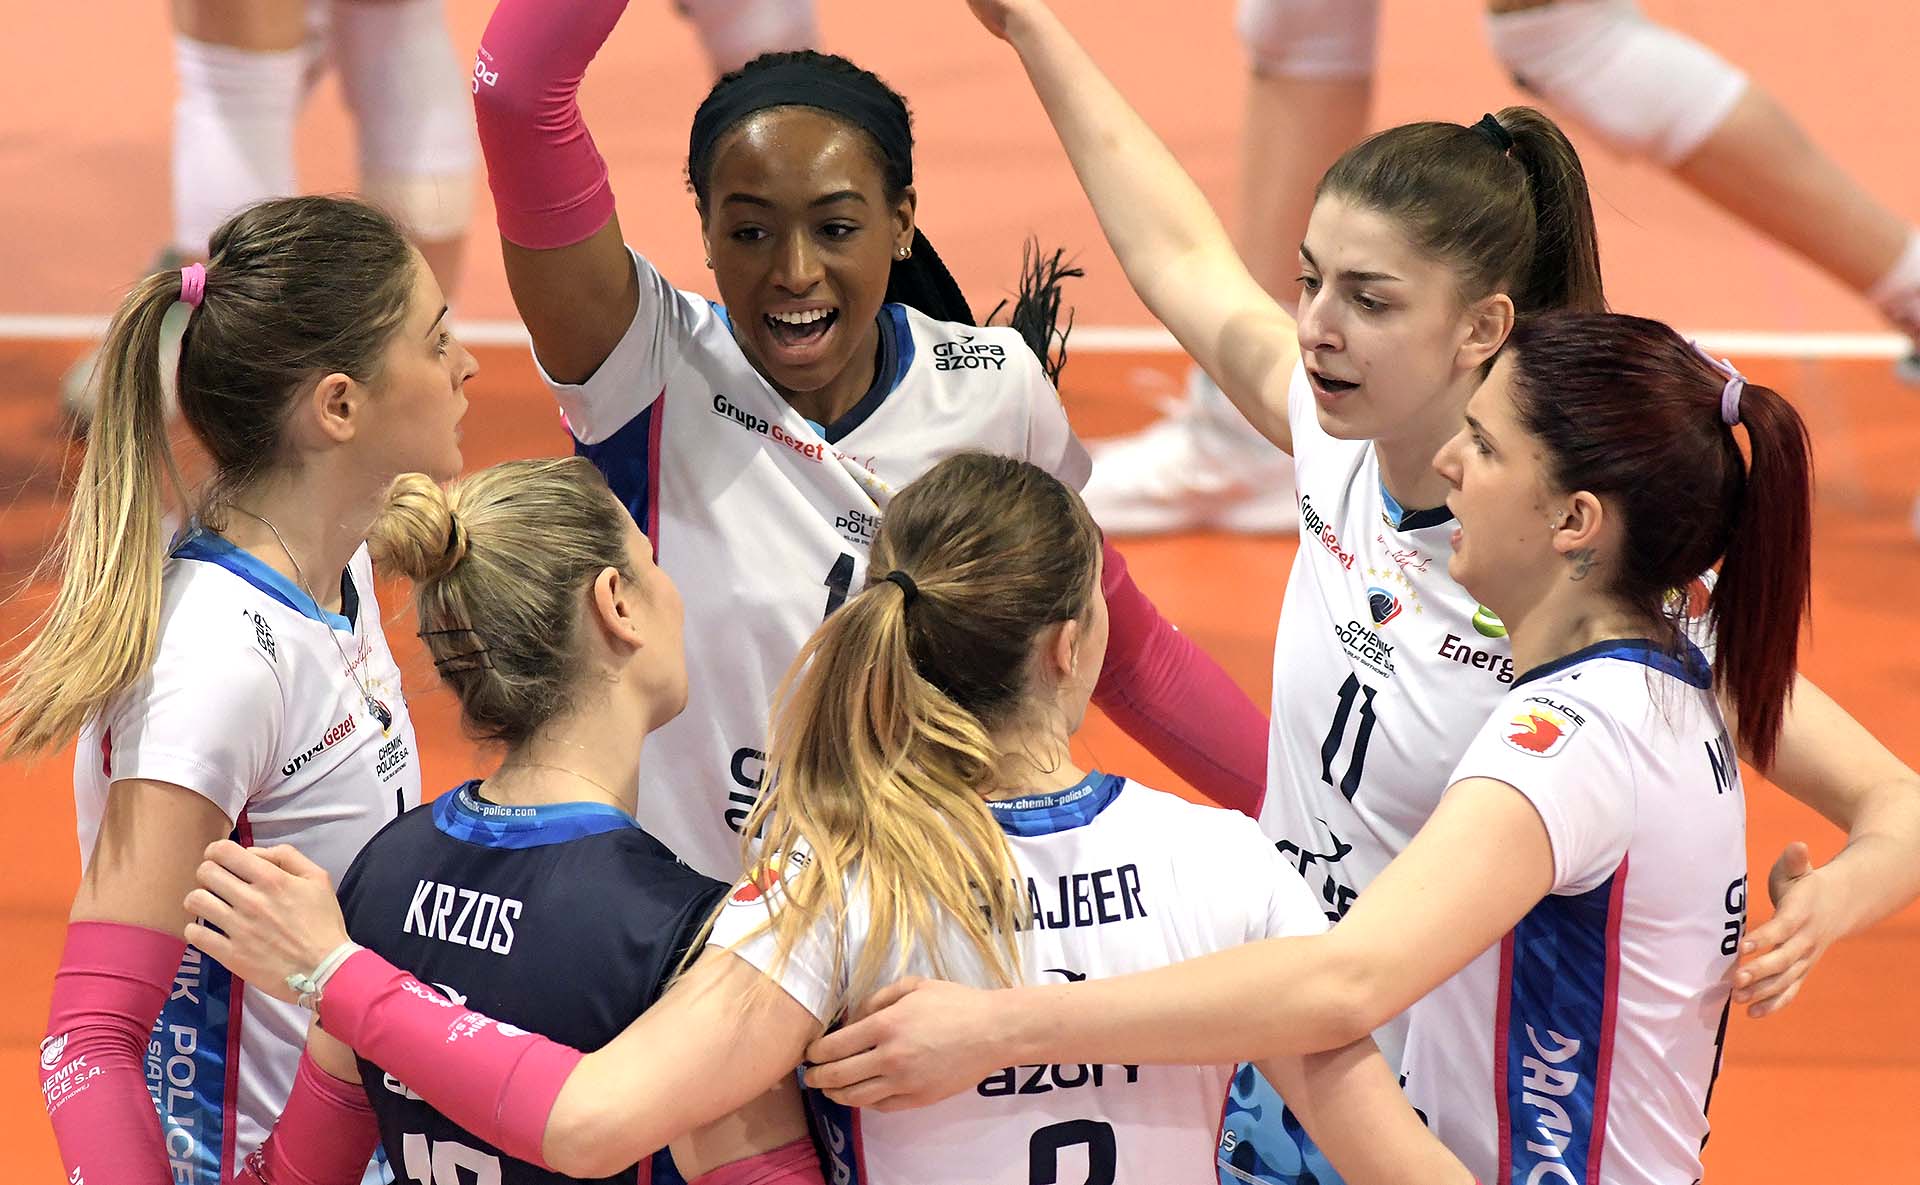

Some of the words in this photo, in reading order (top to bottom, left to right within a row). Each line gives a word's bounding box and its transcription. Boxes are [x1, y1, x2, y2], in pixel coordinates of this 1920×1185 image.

[713, 394, 769, 434] Grupa
[771, 424, 824, 461] Gezet
[1321, 524, 1355, 571] Gezet
[323, 713, 356, 747] Gezet
[1320, 671, 1378, 804] 11
[402, 879, 524, 956] KRZOS
